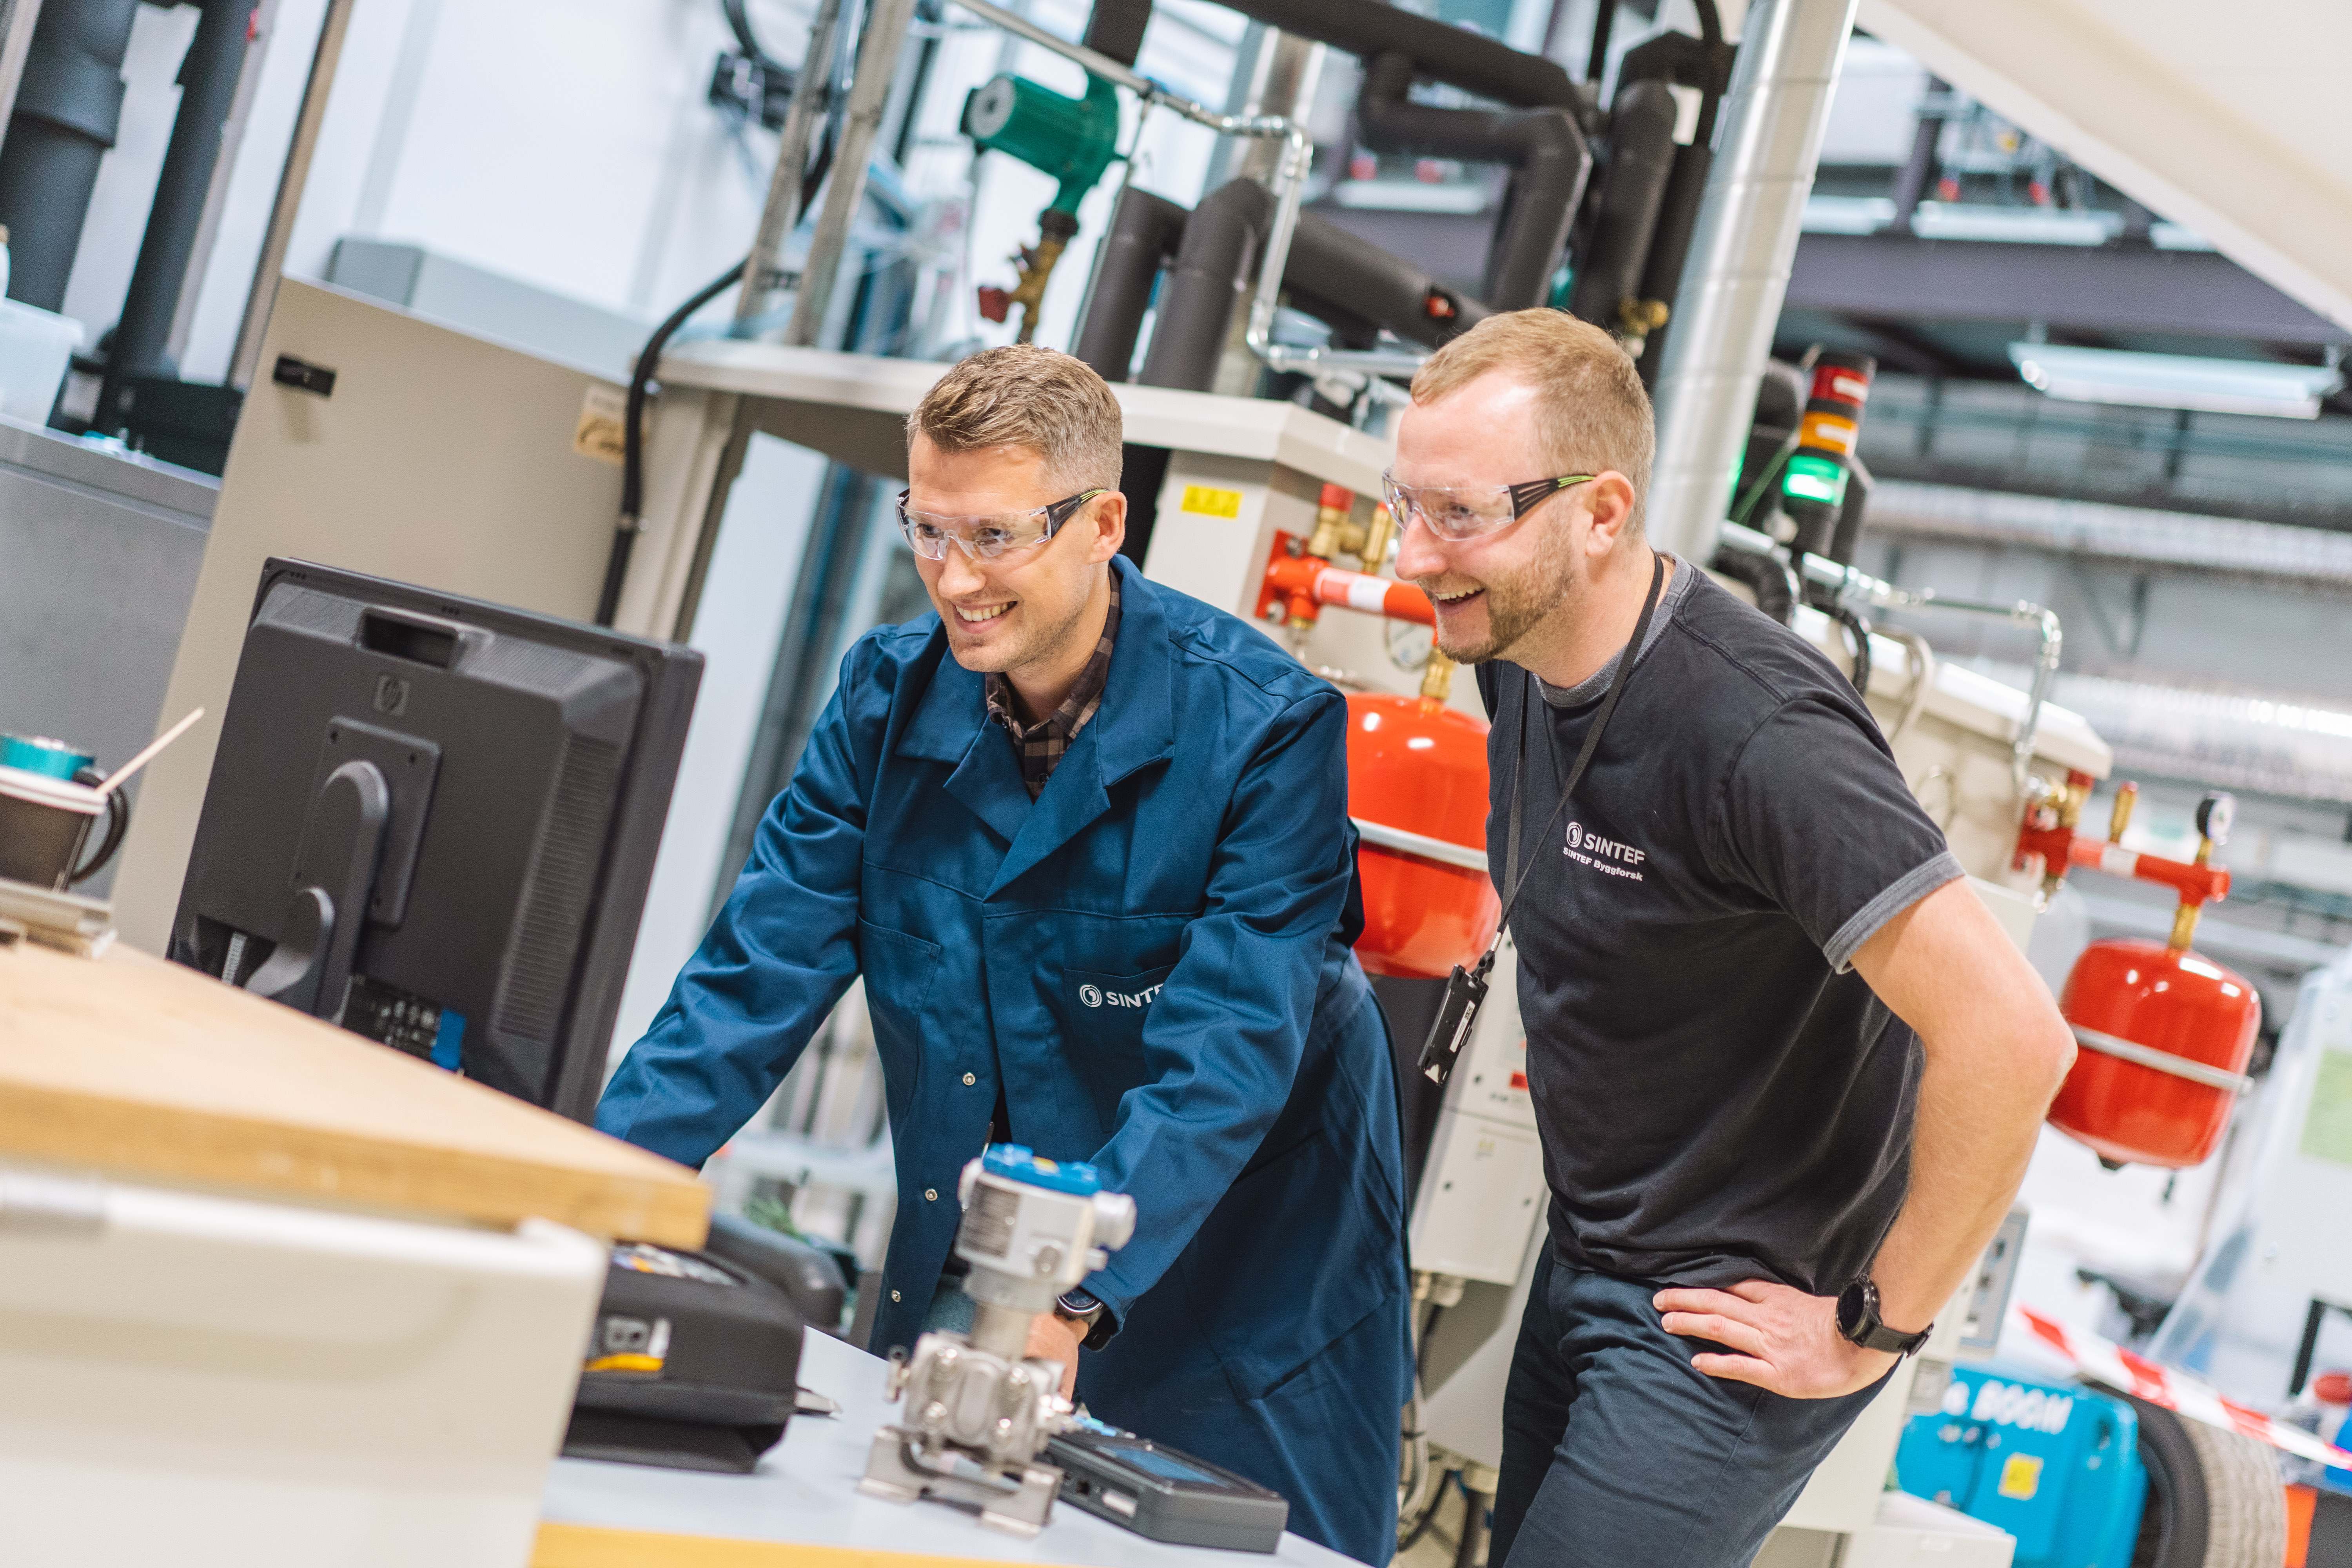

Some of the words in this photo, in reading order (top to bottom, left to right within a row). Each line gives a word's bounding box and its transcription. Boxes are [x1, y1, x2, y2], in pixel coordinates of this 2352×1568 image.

[1563, 847, 1592, 865] SINTEF
[1593, 860, 1643, 881] Byggforsk
[1584, 833, 1645, 865] SINTEF
